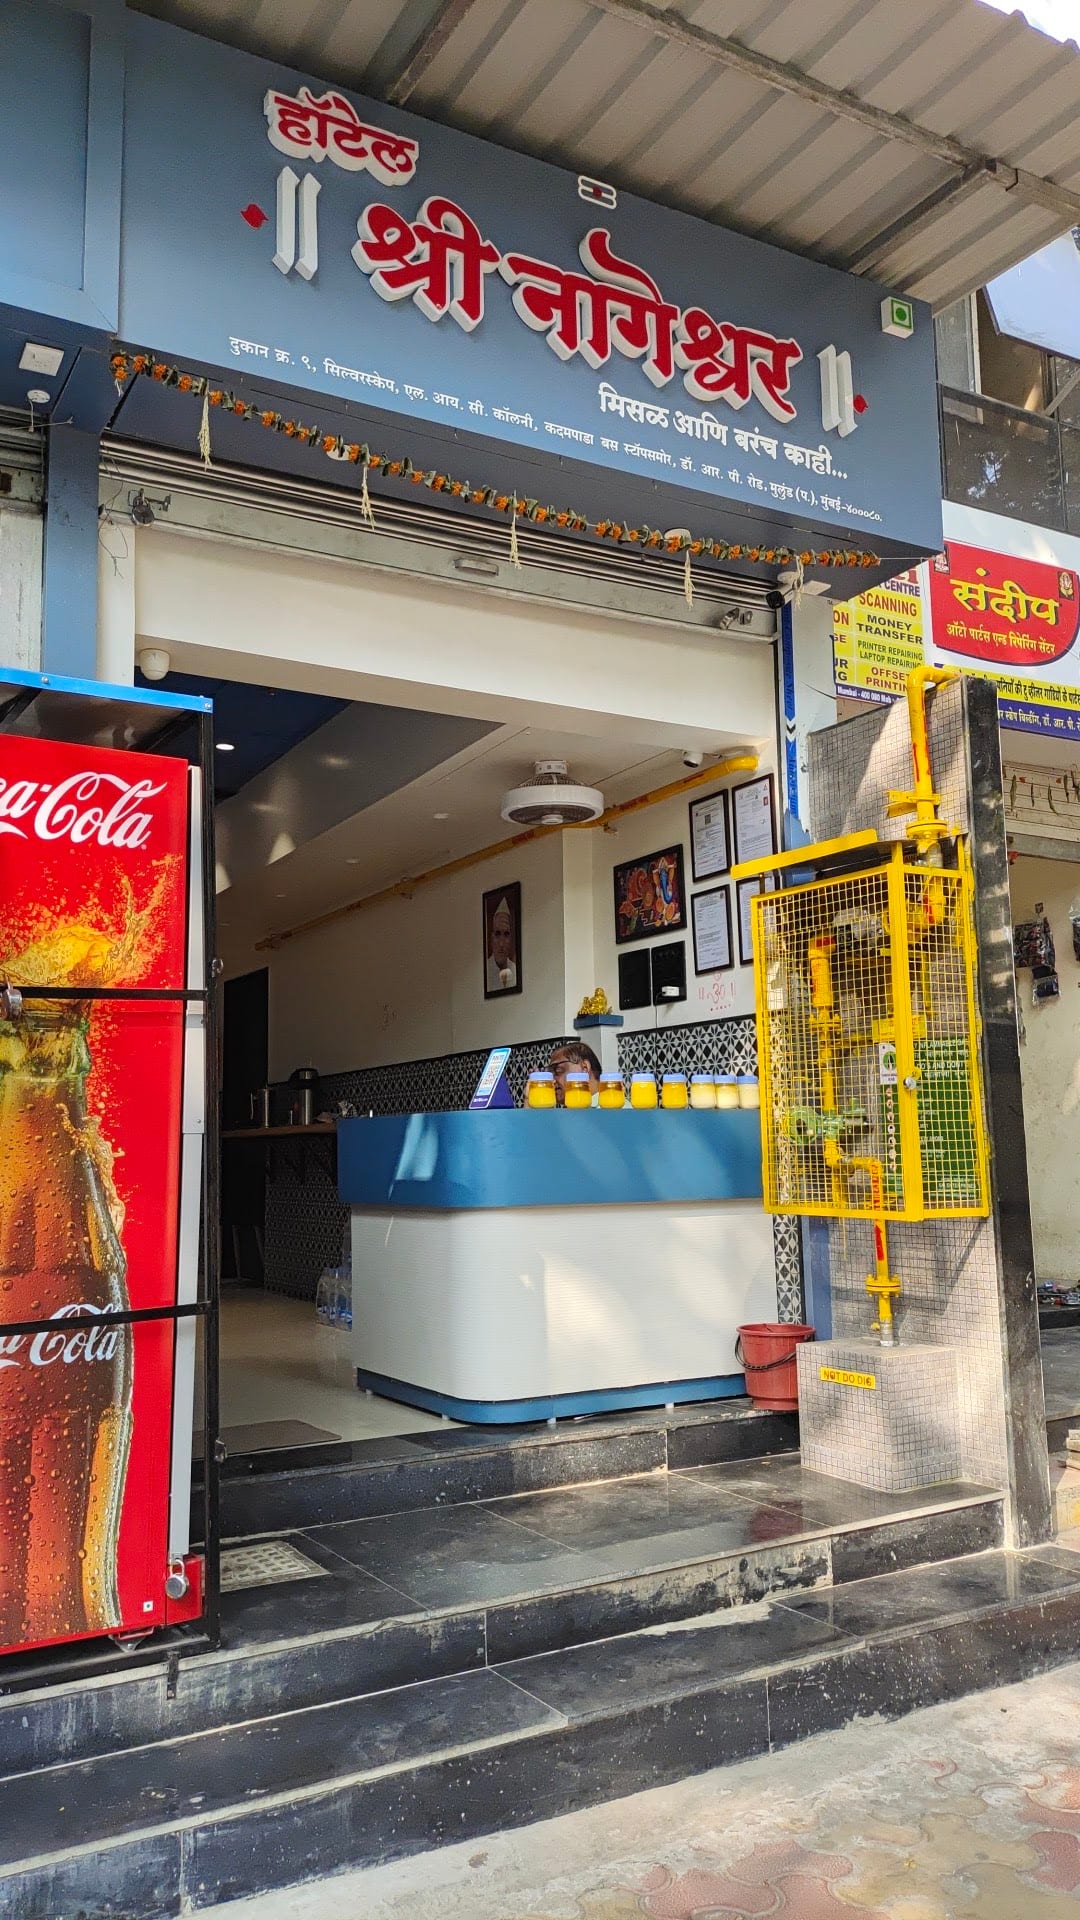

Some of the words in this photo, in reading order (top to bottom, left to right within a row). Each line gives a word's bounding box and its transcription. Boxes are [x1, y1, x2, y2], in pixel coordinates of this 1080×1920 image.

[264, 87, 419, 186] हॉटेल
[351, 196, 503, 333] श्री
[500, 228, 802, 424] नागेश्वर
[229, 336, 268, 358] दुकान
[274, 349, 295, 366] क्र.
[323, 357, 399, 394] सिल्वरस्केप,
[404, 384, 428, 401] एल.
[433, 391, 464, 411] आय.
[468, 400, 488, 417] सी.
[492, 407, 538, 432] कॉलनी,
[544, 421, 594, 445] कदमपाडा
[600, 437, 619, 452] बस
[624, 442, 677, 468] स्टॉपसमोर,
[680, 456, 697, 473] डॉ.
[701, 464, 724, 480] आर.
[728, 469, 743, 485] पी.
[747, 473, 767, 492] रोड,
[769, 479, 793, 500] मुलुंड
[598, 382, 669, 428] मिसळ
[673, 411, 728, 446] आणि
[733, 427, 778, 460] बरंच
[783, 444, 848, 480] काही...
[885, 580, 920, 597] CENTRE
[950, 567, 1060, 625] संदीप
[859, 592, 917, 617] SCANNING
[867, 614, 912, 631] MONEY
[946, 620, 967, 638] ऑटो
[856, 623, 923, 645] TRANSFER
[857, 640, 886, 653] PRINTER
[888, 646, 923, 660] REPAIRING
[859, 651, 885, 662] LAPTOP
[866, 677, 908, 692] PRINTIN
[0, 771, 168, 849] a-Cola
[823, 1370, 841, 1381] NOT
[843, 1373, 855, 1384] DO
[857, 1376, 872, 1387] DIG
